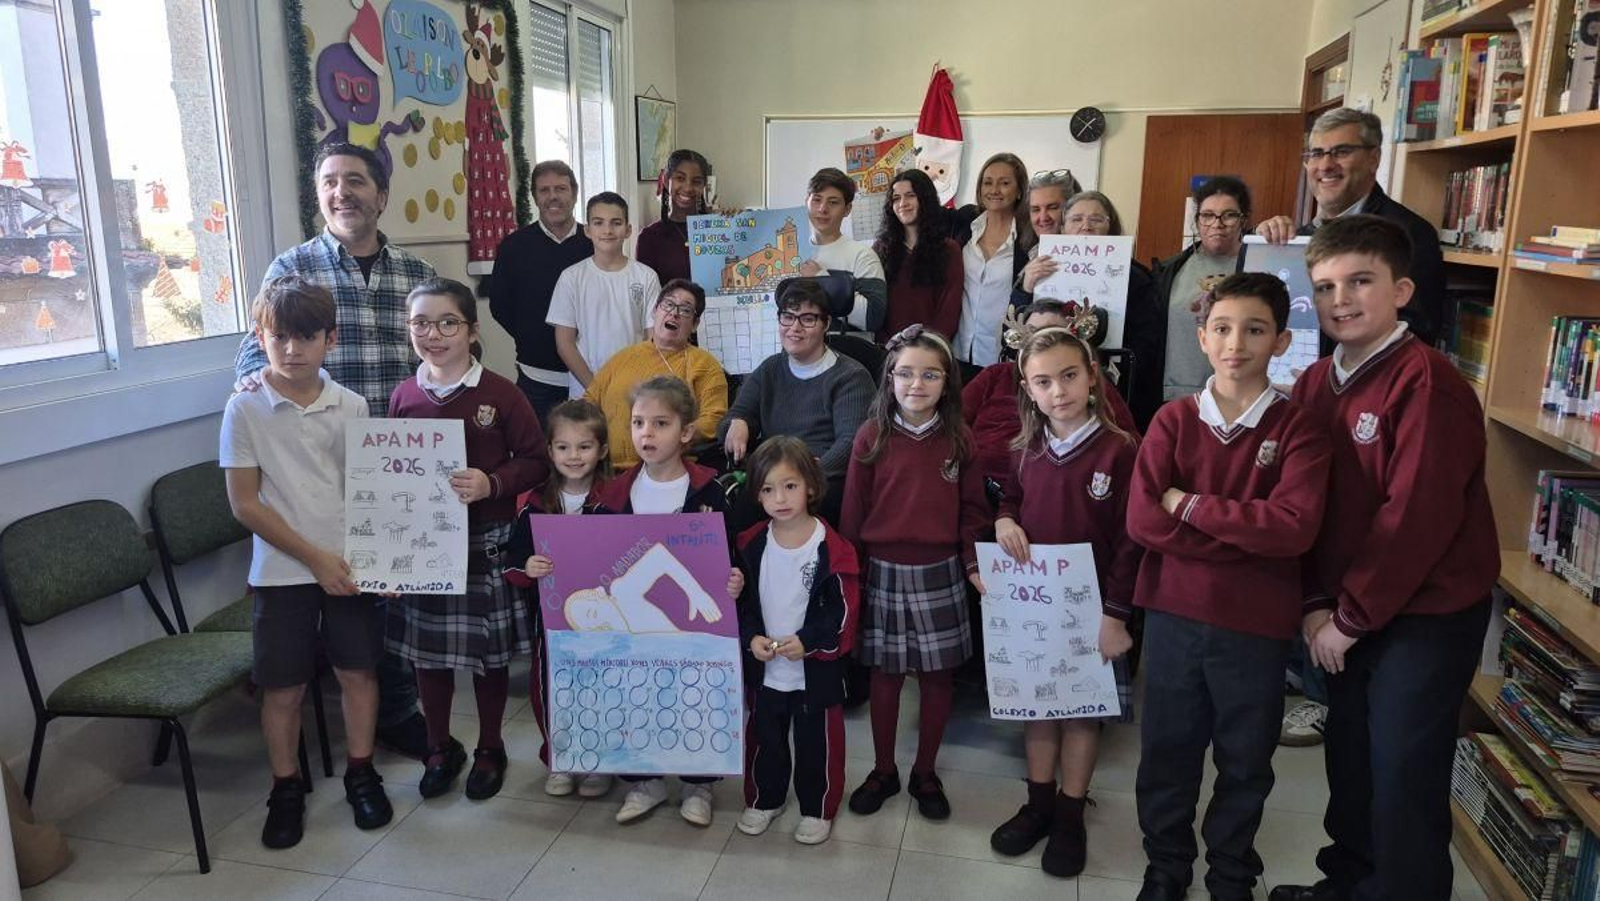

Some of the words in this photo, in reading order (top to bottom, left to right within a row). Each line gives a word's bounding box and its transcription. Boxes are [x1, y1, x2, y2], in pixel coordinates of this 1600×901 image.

[1064, 262, 1097, 276] 2026
[381, 456, 426, 477] 2026
[1008, 583, 1053, 605] 2026
